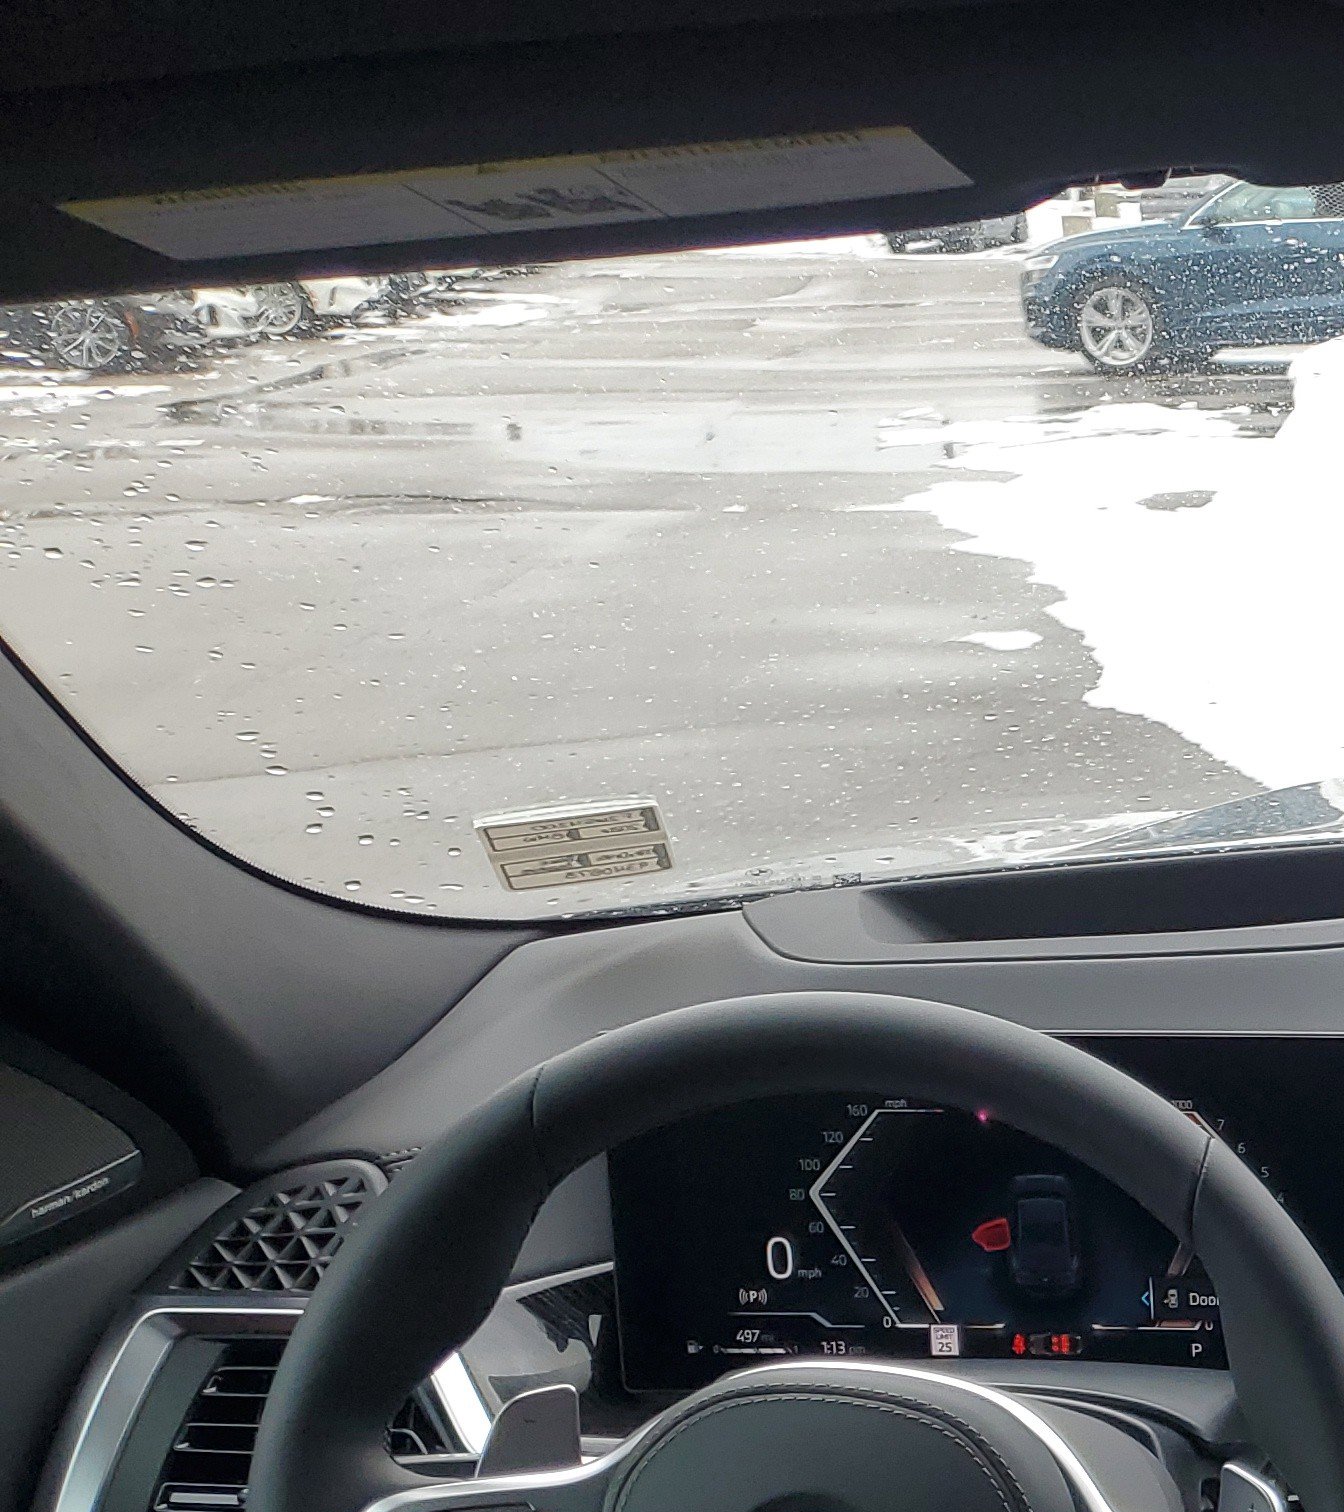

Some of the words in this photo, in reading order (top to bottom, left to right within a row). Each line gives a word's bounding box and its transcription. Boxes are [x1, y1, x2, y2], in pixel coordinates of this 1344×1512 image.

[885, 1099, 907, 1109] mph
[847, 1104, 868, 1117] 160
[1217, 1119, 1225, 1131] 7
[822, 1131, 844, 1143] 120
[1238, 1142, 1246, 1154] 6
[799, 1159, 821, 1171] 100
[1261, 1166, 1270, 1178] 5
[789, 1188, 805, 1201] 80
[809, 1221, 824, 1234] 60
[766, 1236, 793, 1280] 0
[798, 1268, 822, 1280] mph
[831, 1254, 847, 1266] 40
[853, 1287, 869, 1299] 20
[883, 1317, 892, 1328] 0
[736, 1329, 760, 1343] 497
[820, 1341, 846, 1355] 1:13
[938, 1341, 952, 1353] 25
[1191, 1343, 1202, 1357] P
